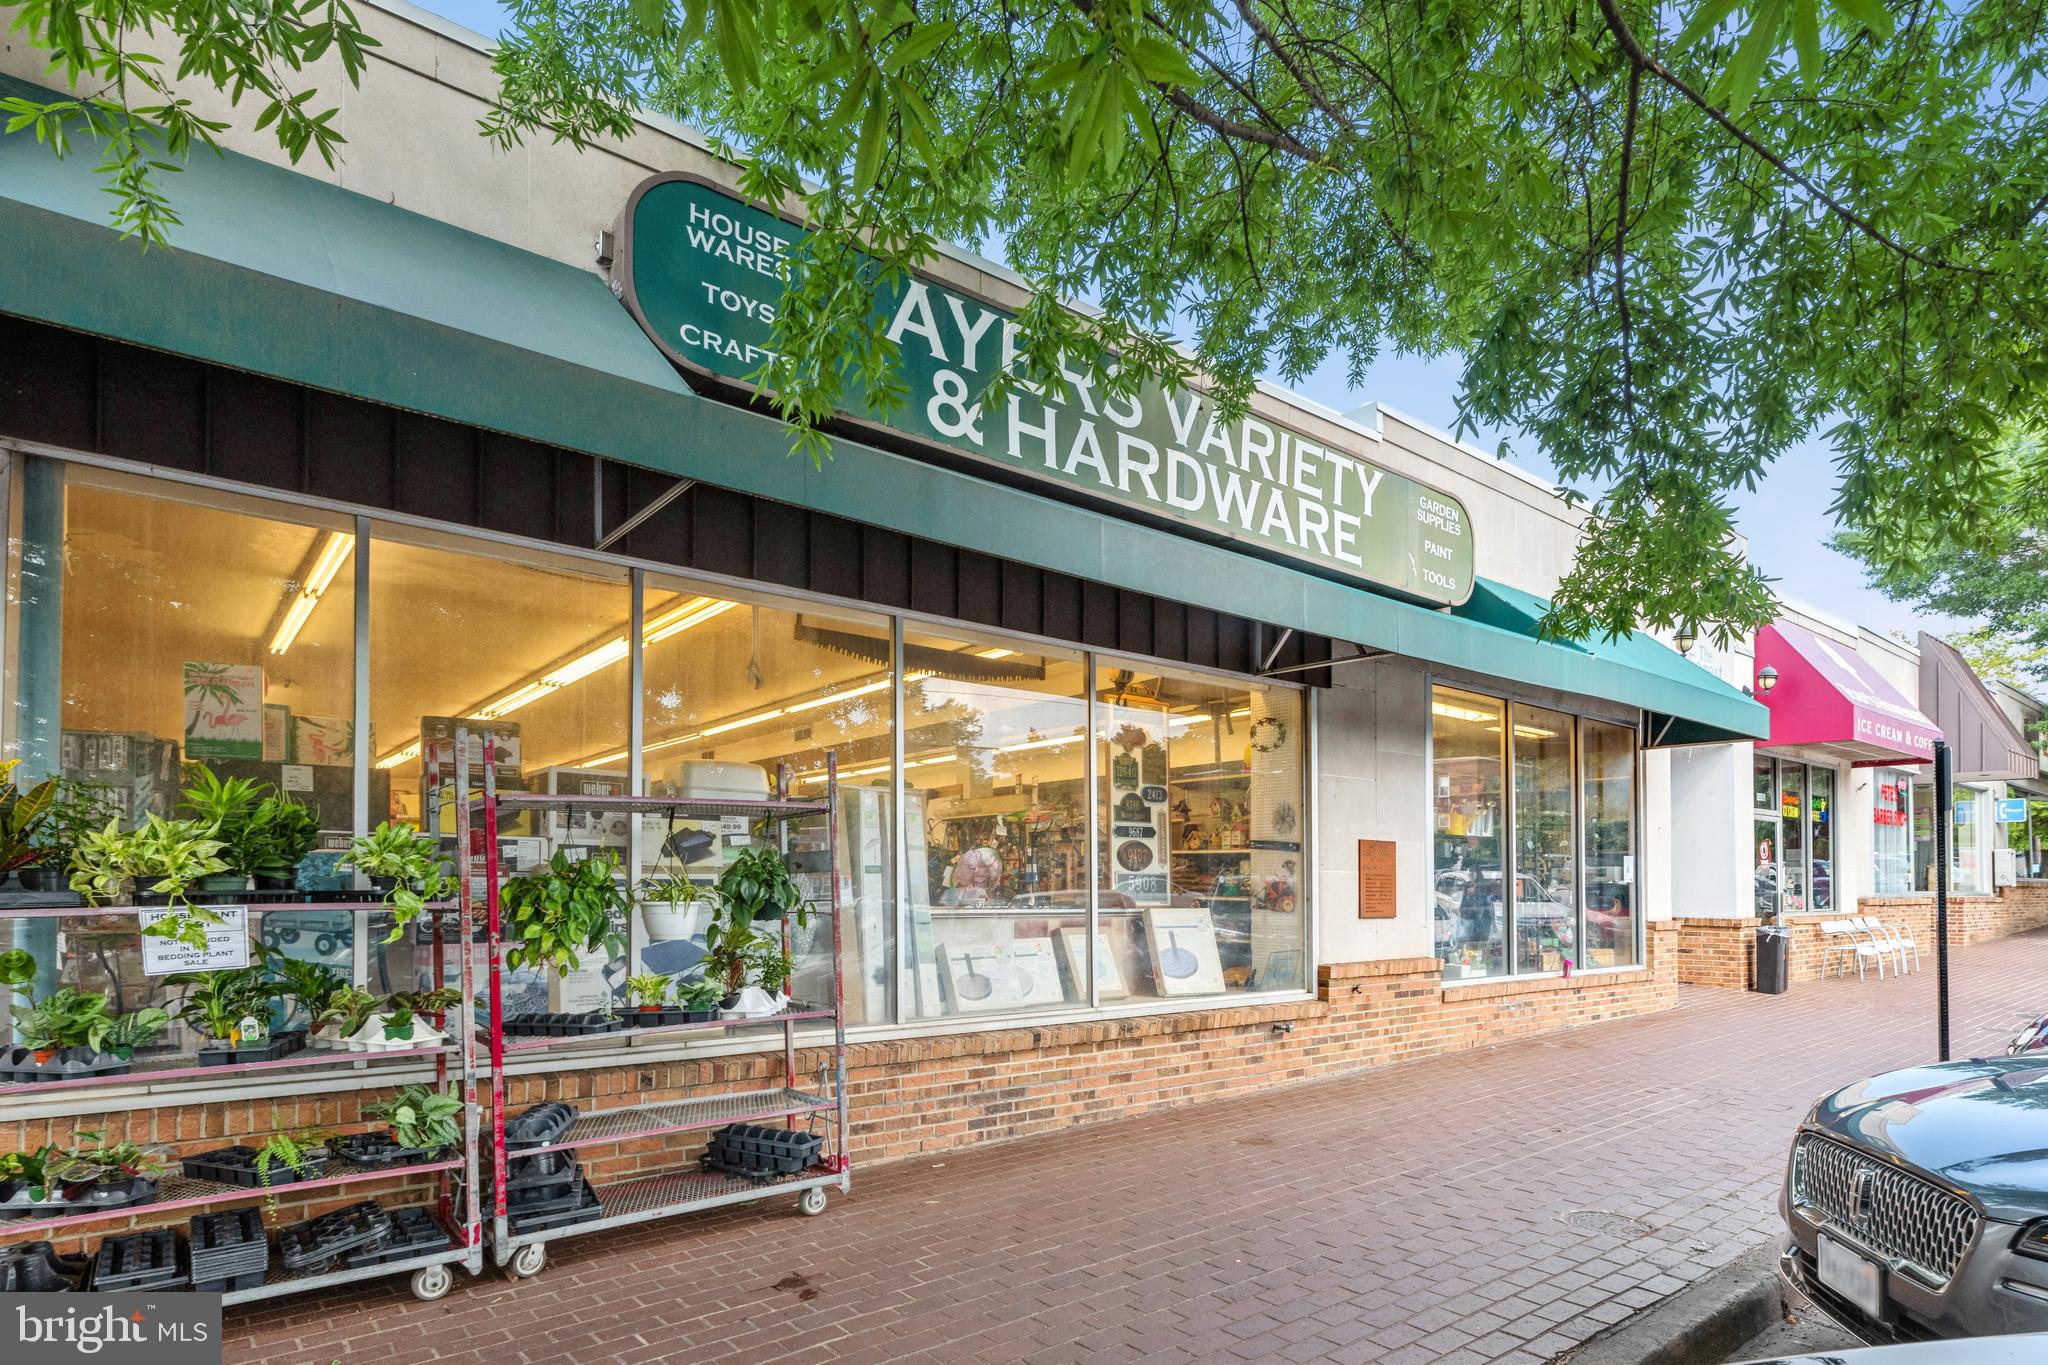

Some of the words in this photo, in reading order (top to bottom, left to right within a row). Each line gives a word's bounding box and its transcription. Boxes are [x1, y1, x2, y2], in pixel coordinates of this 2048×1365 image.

[690, 203, 791, 261] HOUSE
[686, 225, 792, 282] WARES
[702, 281, 776, 324] TOYS
[1163, 385, 1385, 518] VARIETY
[927, 369, 984, 447] &
[1007, 393, 1363, 568] HARDWARE
[1420, 496, 1459, 521] GARDEN
[1417, 509, 1461, 536] SUPPLIES
[1424, 540, 1453, 560] PAINT
[1422, 568, 1456, 590] TOOLS
[1858, 717, 1873, 735] ICE
[1875, 724, 1903, 742] CREAM
[1905, 731, 1912, 745] &
[1914, 735, 1934, 750] COFF
[583, 781, 612, 796] weber
[1147, 788, 1163, 800] 2413
[1128, 875, 1157, 892] 5908
[158, 952, 201, 961] BEDDING
[203, 950, 234, 958] PLANT
